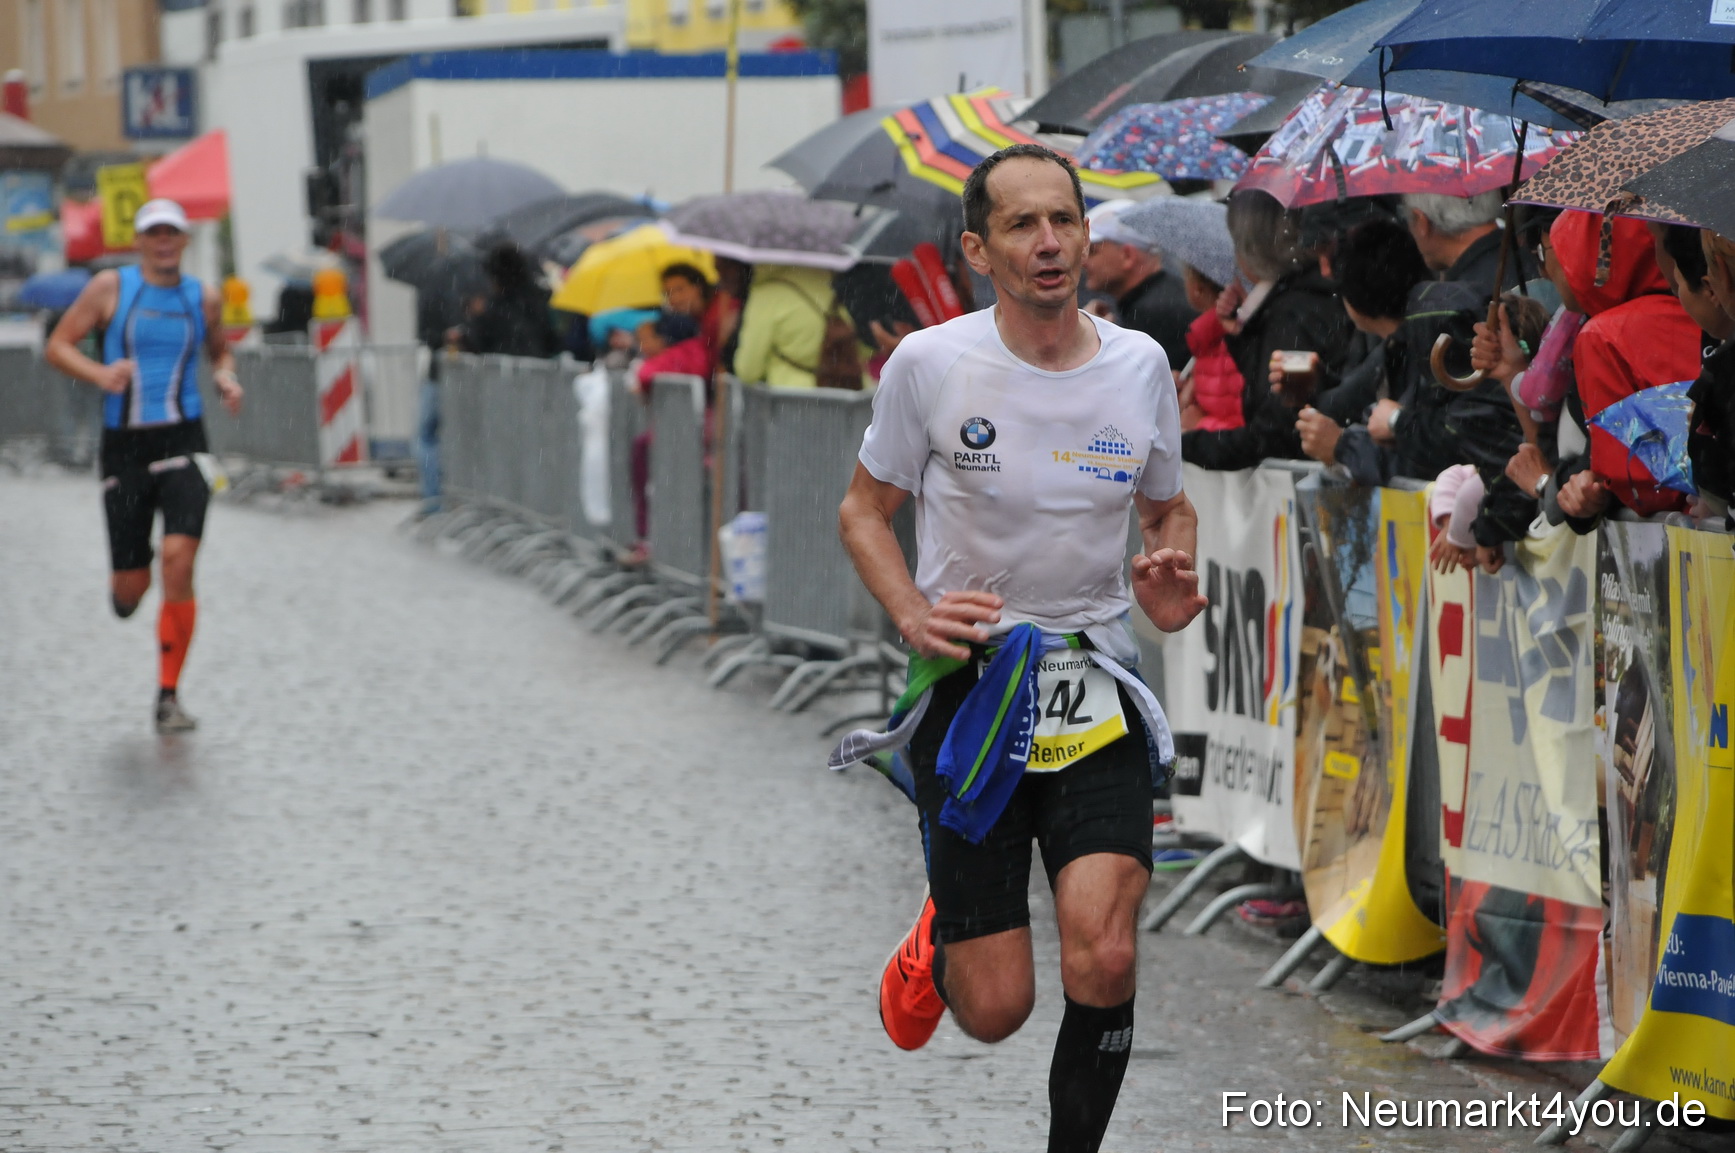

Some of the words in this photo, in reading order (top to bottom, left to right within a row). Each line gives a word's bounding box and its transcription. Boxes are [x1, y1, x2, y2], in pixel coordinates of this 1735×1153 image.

[953, 451, 1001, 465] PARTL
[1051, 450, 1076, 464] 14.
[954, 462, 1001, 473] Neumarkt
[1037, 656, 1091, 672] Neumarkt
[1034, 677, 1093, 727] 42
